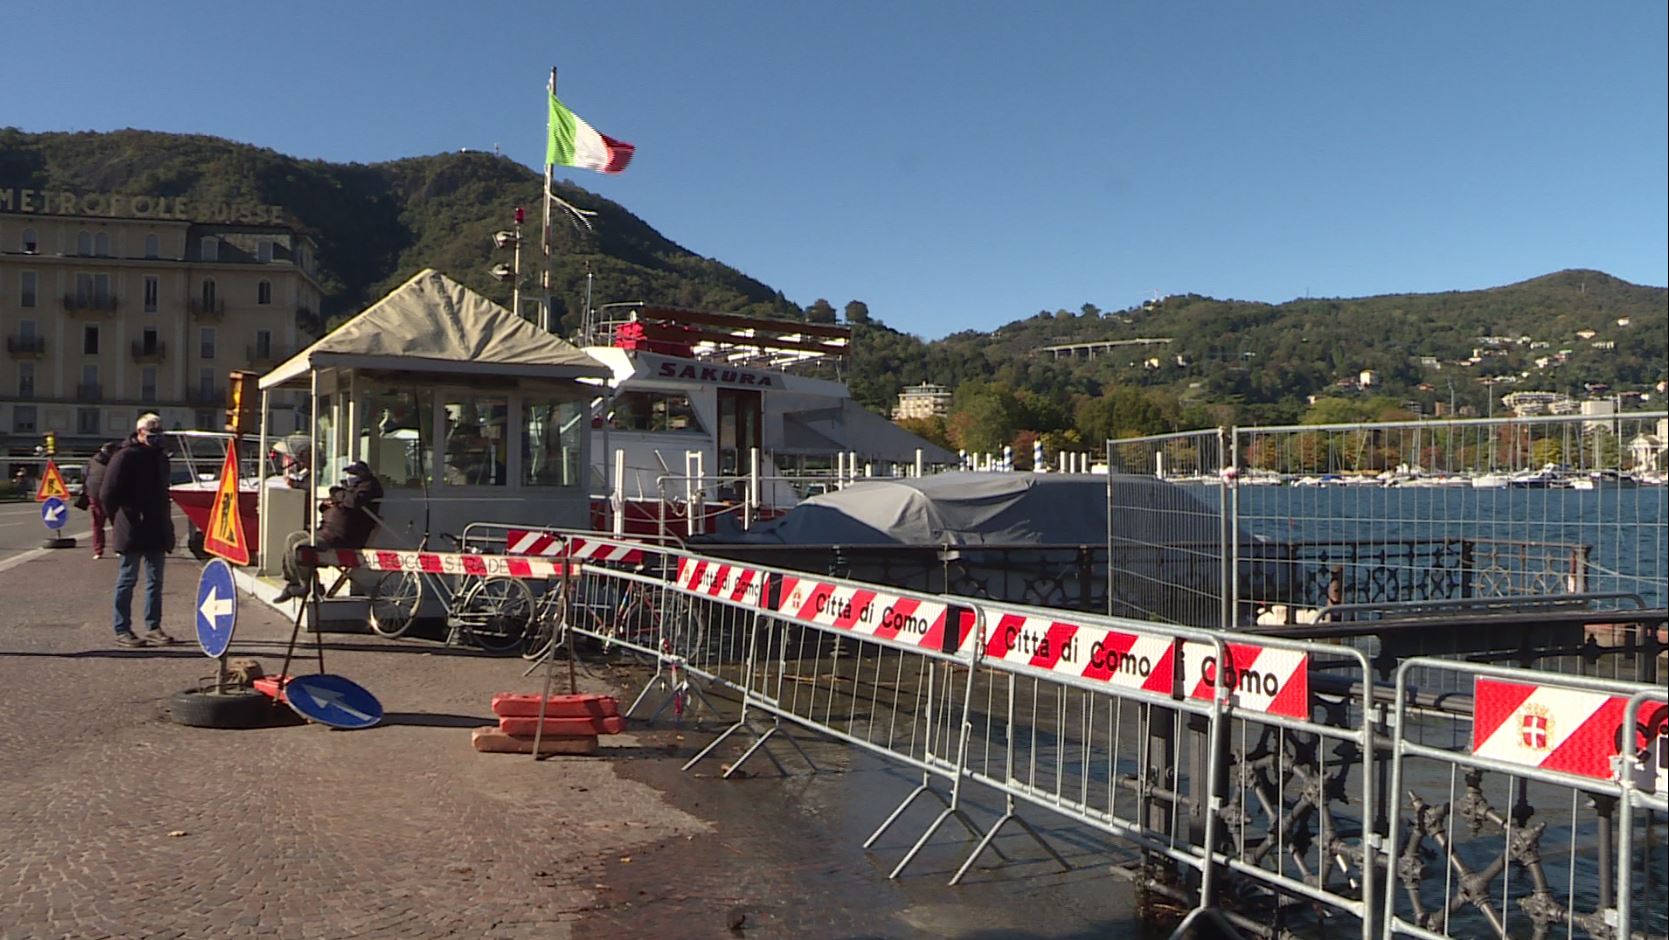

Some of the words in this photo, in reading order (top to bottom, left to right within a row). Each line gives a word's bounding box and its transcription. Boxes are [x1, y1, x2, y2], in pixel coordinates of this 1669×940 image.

[198, 202, 283, 224] SUISSE
[658, 362, 772, 386] SAKURA
[698, 569, 718, 588] Città
[722, 574, 731, 591] di
[816, 593, 852, 619] Città
[860, 602, 874, 624] di
[882, 606, 928, 635] Como
[1005, 625, 1050, 658] Città
[1061, 636, 1078, 663] di
[1090, 641, 1151, 677] Como
